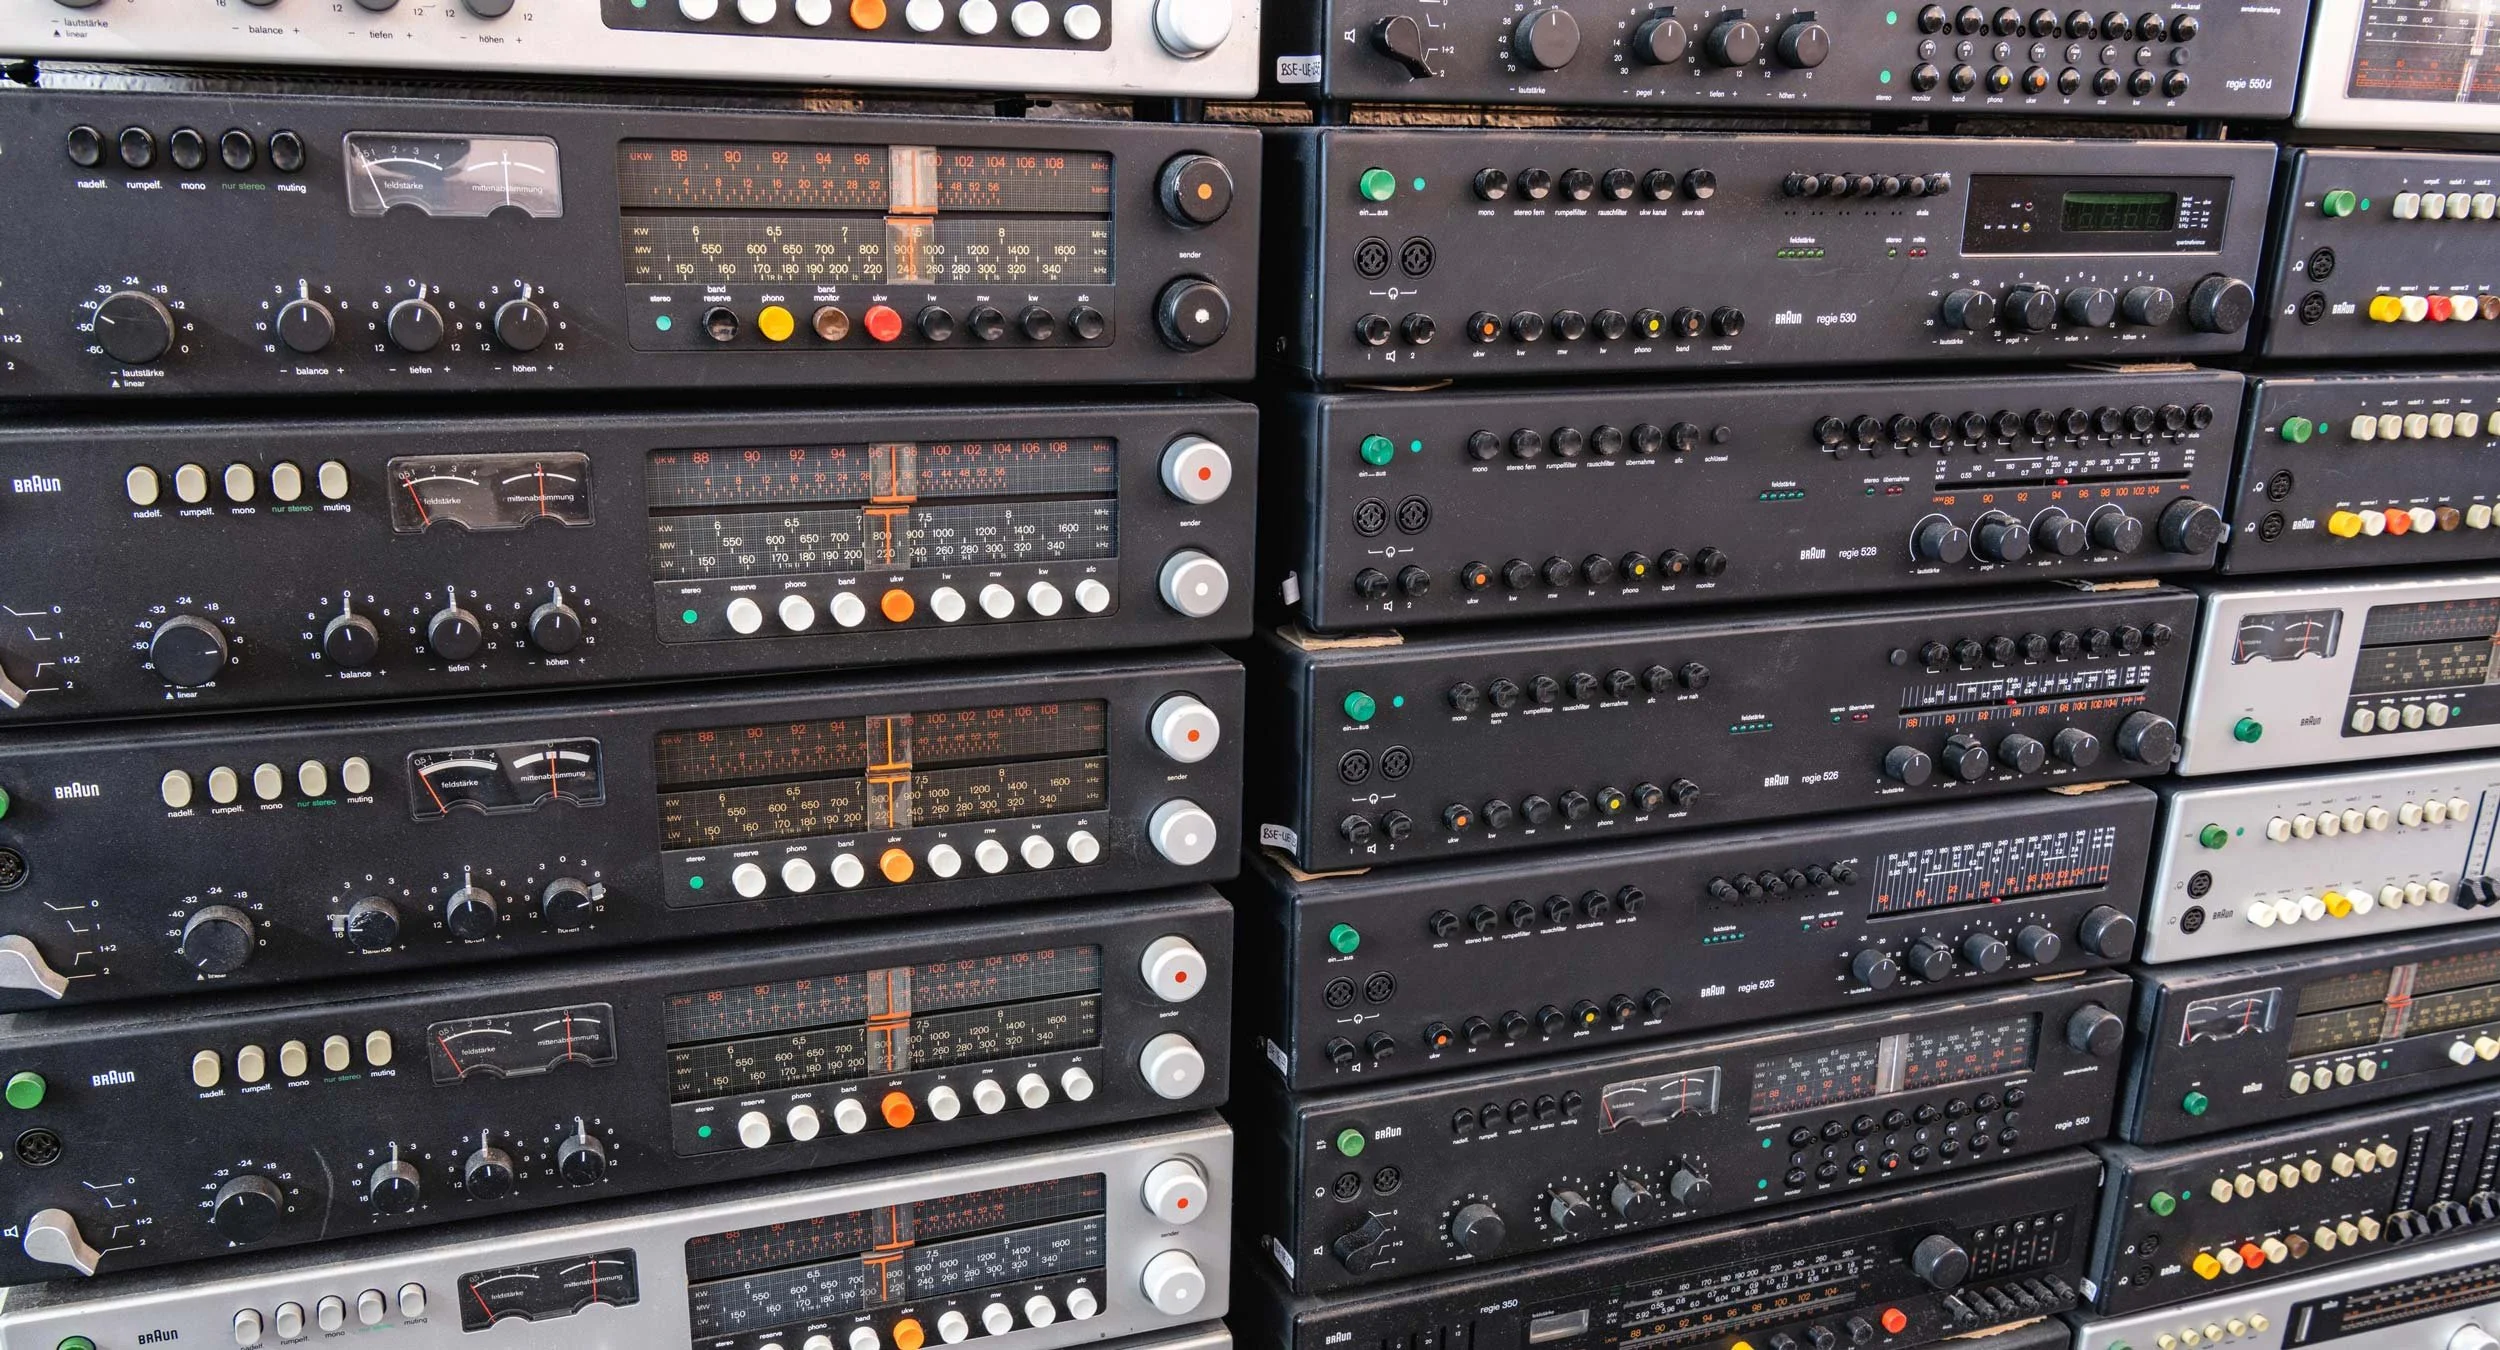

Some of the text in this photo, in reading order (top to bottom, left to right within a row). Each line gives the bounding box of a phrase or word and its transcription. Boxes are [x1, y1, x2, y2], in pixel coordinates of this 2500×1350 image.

[64, 18, 108, 28] lautstärke
[66, 30, 88, 38] linear
[249, 25, 283, 34] balance
[369, 31, 393, 39] tiefen
[479, 35, 504, 43] höhen
[2226, 78, 2247, 91] regie
[1636, 89, 1652, 98] pegel
[630, 150, 1064, 169] UKW 88 90 92 94 96 102 104 108
[77, 180, 108, 189] nadelf.
[126, 180, 163, 191] rumpelf.
[277, 183, 307, 194] muting
[384, 179, 423, 191] feldstärke
[635, 244, 1076, 256] MW 550 600 700 800 1000 1400 1600
[122, 276, 139, 285] -24
[707, 285, 726, 293] band
[817, 285, 836, 293] band
[761, 294, 785, 303] phono
[813, 294, 840, 302] monitor
[872, 294, 887, 302] ukw
[1078, 294, 1089, 302] afc
[2332, 301, 2355, 314] BRAUN
[1775, 310, 1802, 324] BRAUN
[1817, 313, 1857, 326] regie 530
[76, 323, 94, 332] -50
[122, 369, 164, 377] lautstärke
[296, 367, 329, 375] balance
[409, 366, 432, 374] tiefen
[693, 441, 1067, 464] 88 92 108
[13, 475, 61, 493] BRAUN
[1983, 494, 1993, 503] 90
[2017, 492, 2028, 502] 92
[2116, 487, 2129, 496] 100
[424, 497, 461, 505] feldstärke
[180, 507, 215, 517] rumpelf.
[323, 503, 351, 512] muting
[133, 509, 162, 518] nadelf.
[1180, 519, 1201, 527] sender
[2292, 517, 2315, 530] BRAUN
[1800, 547, 1826, 560] BRAUN
[1839, 546, 1877, 560] regie 528
[838, 577, 856, 585] band
[890, 575, 904, 583] ukw
[785, 581, 807, 589] phono
[63, 656, 80, 664] 1+2
[546, 658, 569, 666] höhen
[448, 664, 470, 672] tiefen
[340, 671, 372, 679] balance
[1764, 774, 1789, 787] BRAUN
[1802, 771, 1839, 784] regie 526
[441, 779, 479, 788] feldstärke
[54, 782, 100, 799] BRAUN
[347, 796, 373, 804] muting
[168, 809, 195, 818] nadelf.
[211, 805, 244, 815] rumpelf.
[786, 845, 807, 854] phono
[1738, 979, 1775, 993] regie 525
[1701, 985, 1725, 998] BRAUN
[1159, 1010, 1179, 1018] sender
[461, 1047, 496, 1055] feldstärke
[370, 1069, 396, 1077] muting
[92, 1070, 135, 1087] BRAUN
[241, 1083, 272, 1093] rumpelf.
[2055, 1116, 2090, 1130] regie 550
[1375, 1126, 1401, 1140] BRAUN
[1480, 1299, 1518, 1314] regie 350
[1678, 1297, 1788, 1328] 92 96 100
[138, 1329, 178, 1345] BRAUN
[1326, 1332, 1352, 1345] BRAUN
